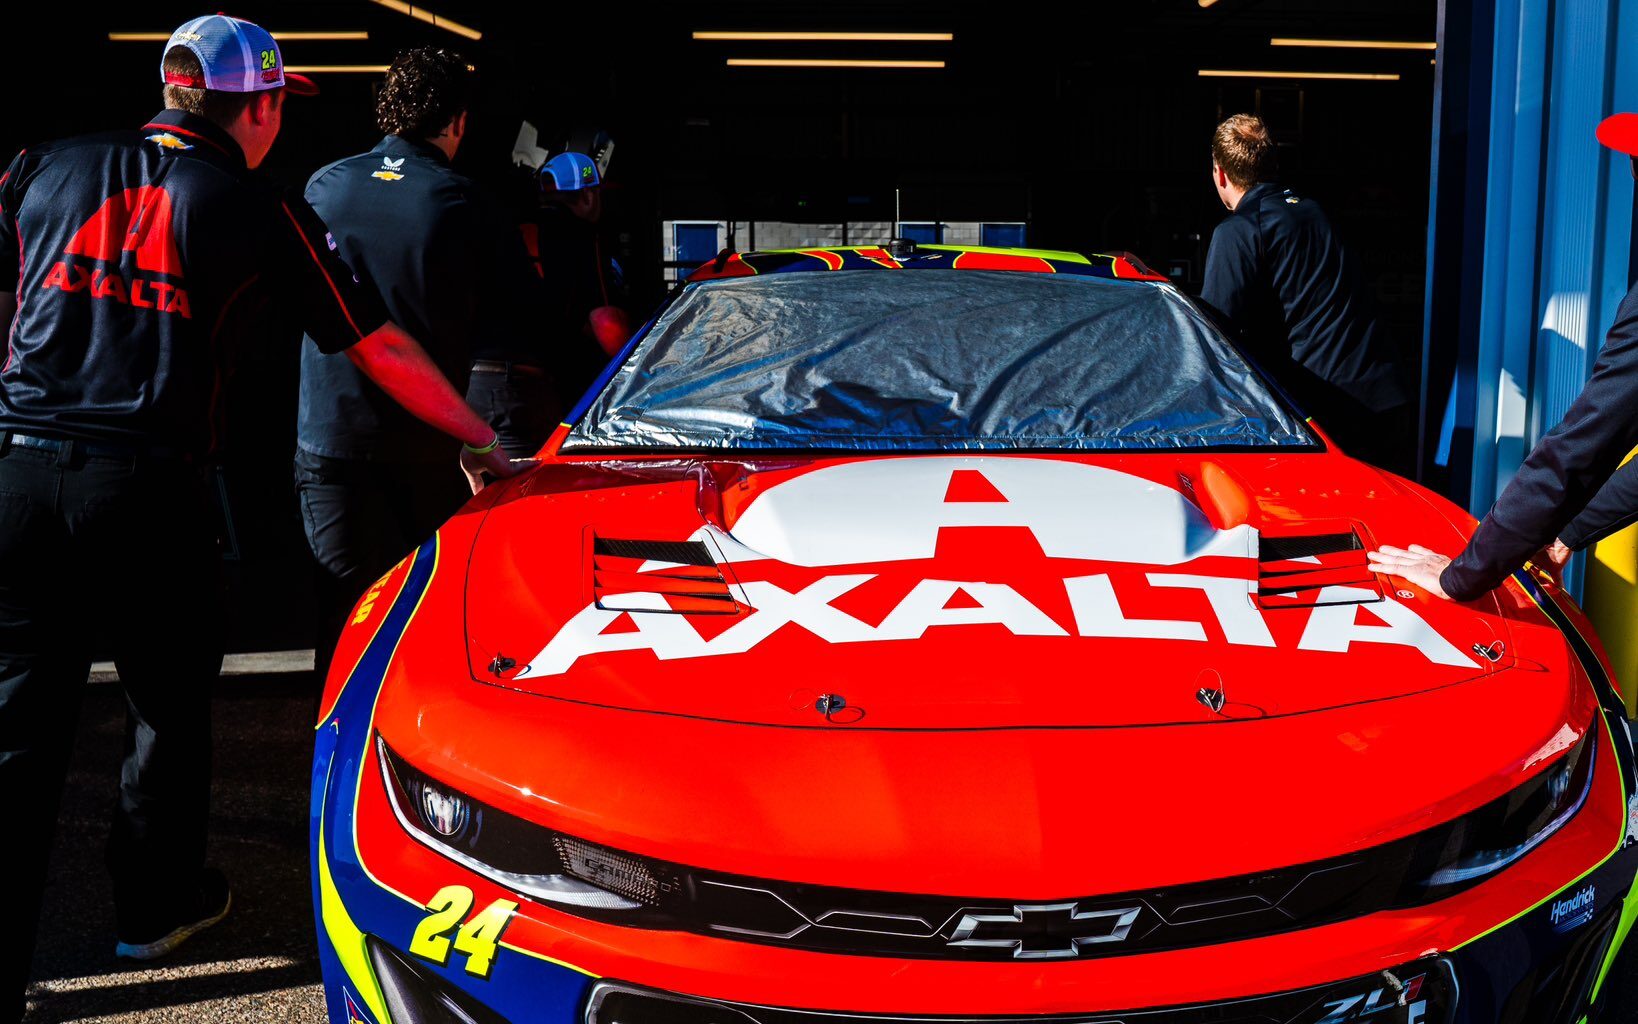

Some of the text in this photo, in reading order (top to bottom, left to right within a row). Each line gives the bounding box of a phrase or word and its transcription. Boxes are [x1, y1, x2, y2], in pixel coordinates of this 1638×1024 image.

[261, 49, 277, 69] 24
[583, 166, 592, 177] 24
[42, 260, 193, 321] AXALTA
[512, 572, 1484, 680] AXALTA
[1551, 884, 1596, 924] Hendrick
[409, 885, 519, 982] 24
